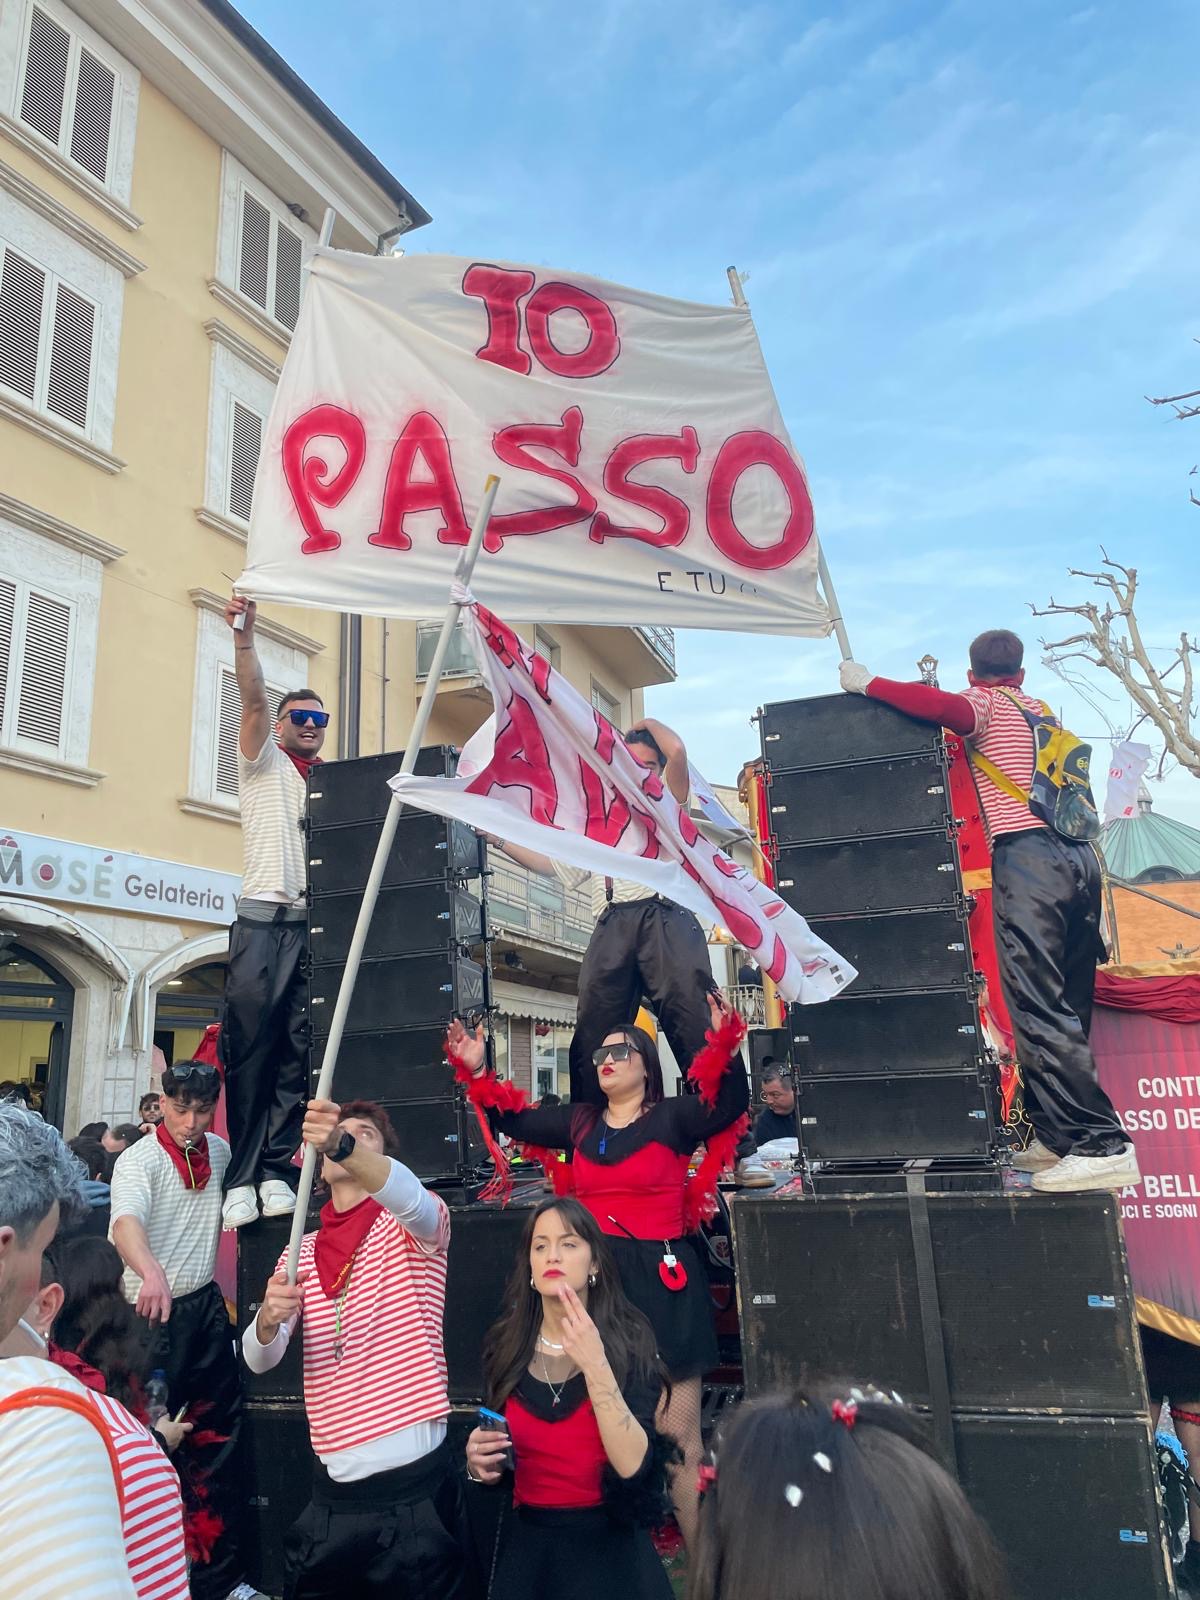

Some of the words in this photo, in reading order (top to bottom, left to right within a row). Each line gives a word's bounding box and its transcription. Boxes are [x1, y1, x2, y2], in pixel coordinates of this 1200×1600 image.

[462, 262, 620, 379] IO
[281, 404, 815, 570] PASSO
[657, 571, 674, 592] E
[686, 571, 726, 595] TU
[124, 874, 224, 911] Gelateria
[1137, 1076, 1200, 1098] CONT
[1143, 1174, 1200, 1198] BELL
[1142, 1204, 1152, 1218] E
[1155, 1203, 1198, 1218] SOGNI
